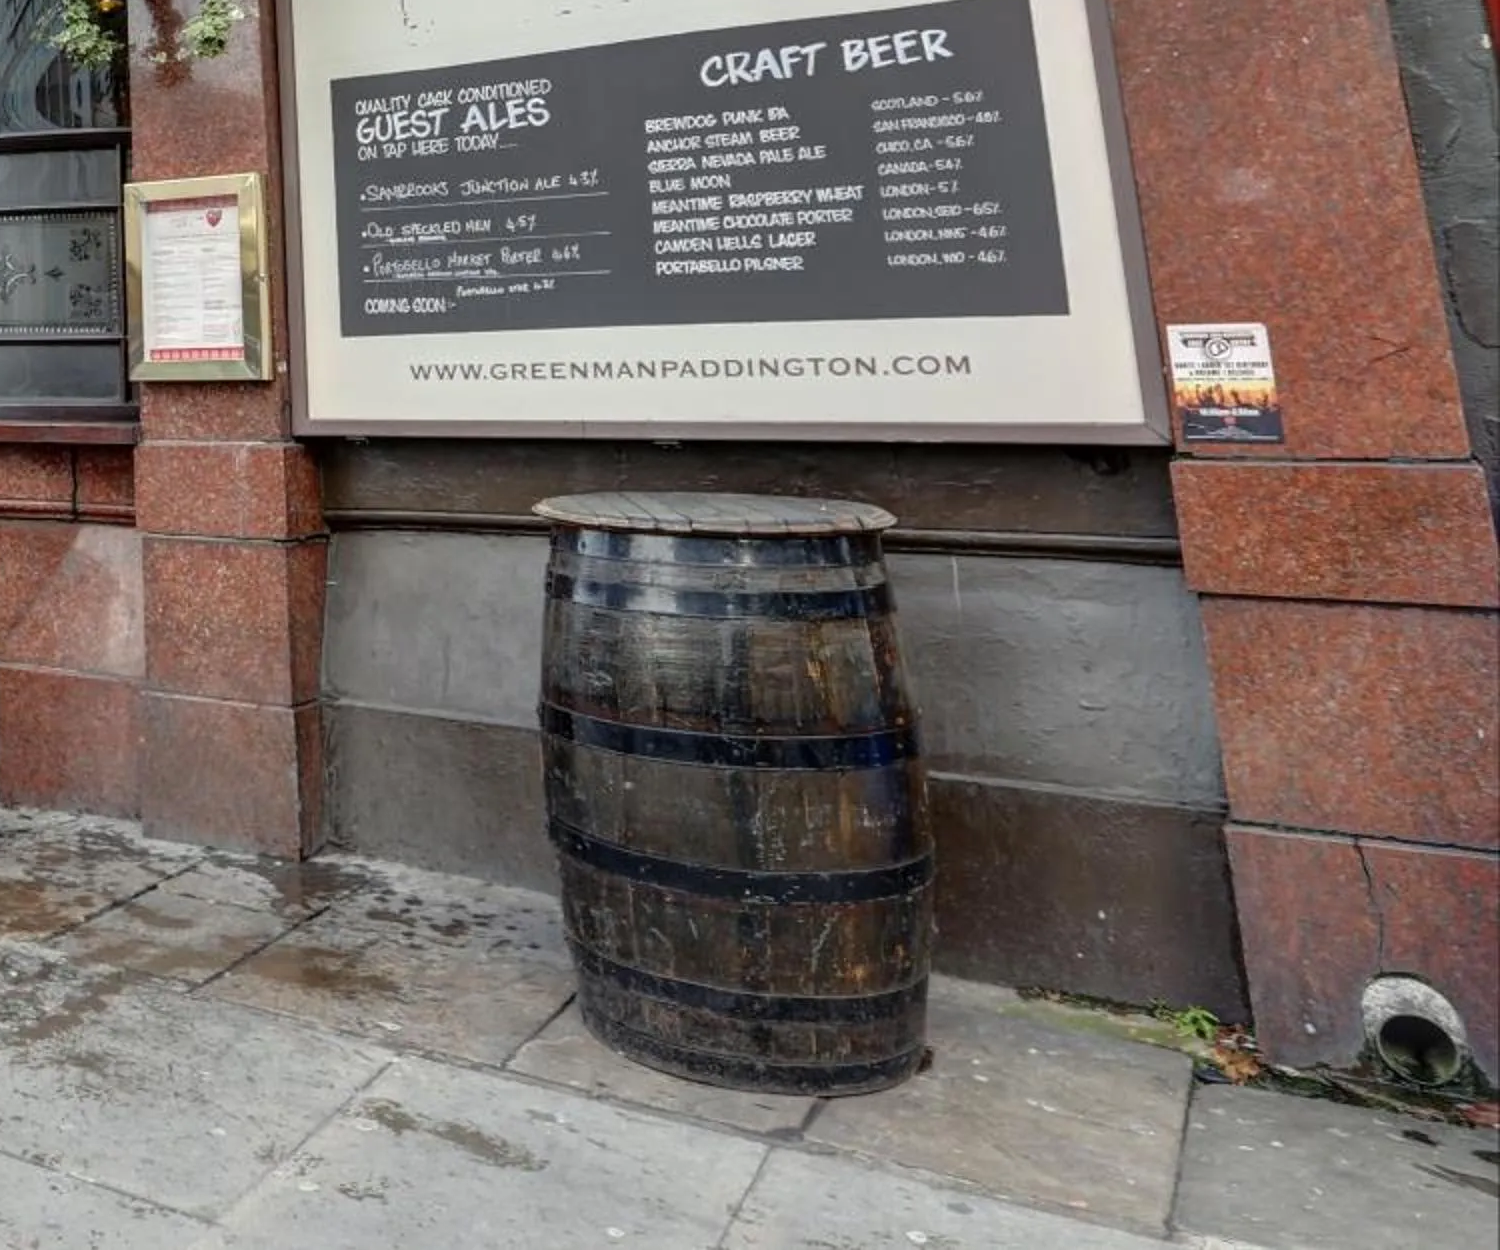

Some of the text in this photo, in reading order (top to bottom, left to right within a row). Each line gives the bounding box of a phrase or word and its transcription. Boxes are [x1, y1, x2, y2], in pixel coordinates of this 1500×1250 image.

[700, 29, 954, 87] CRAFT BEER
[355, 78, 552, 116] QUALITY CASK CONDITIONED
[356, 97, 551, 144] GUEST ALES
[645, 106, 790, 134] BREWDOG PUNK IPA
[357, 145, 378, 161] ON
[383, 142, 407, 159] TAP
[412, 138, 450, 156] HERE
[647, 126, 801, 154] ANCHOR STEAM BEER
[648, 145, 827, 174] SIERRA NEVADA PALE ALE
[460, 177, 529, 197] JUNCTION
[535, 175, 561, 191] ALE
[648, 174, 732, 193] BLUE MOON
[652, 185, 865, 215] MEANTIME RASPBERRY WHEAT
[367, 222, 393, 238] OLD
[653, 208, 853, 234] MEANTIME CHOCOLATE PORTER
[655, 231, 817, 254] CAMDEN HELLS LAGER
[744, 255, 805, 272] PILSNER
[364, 297, 410, 314] COMING
[409, 354, 972, 382] WWW.GREENMANPADDINGTON.COM
